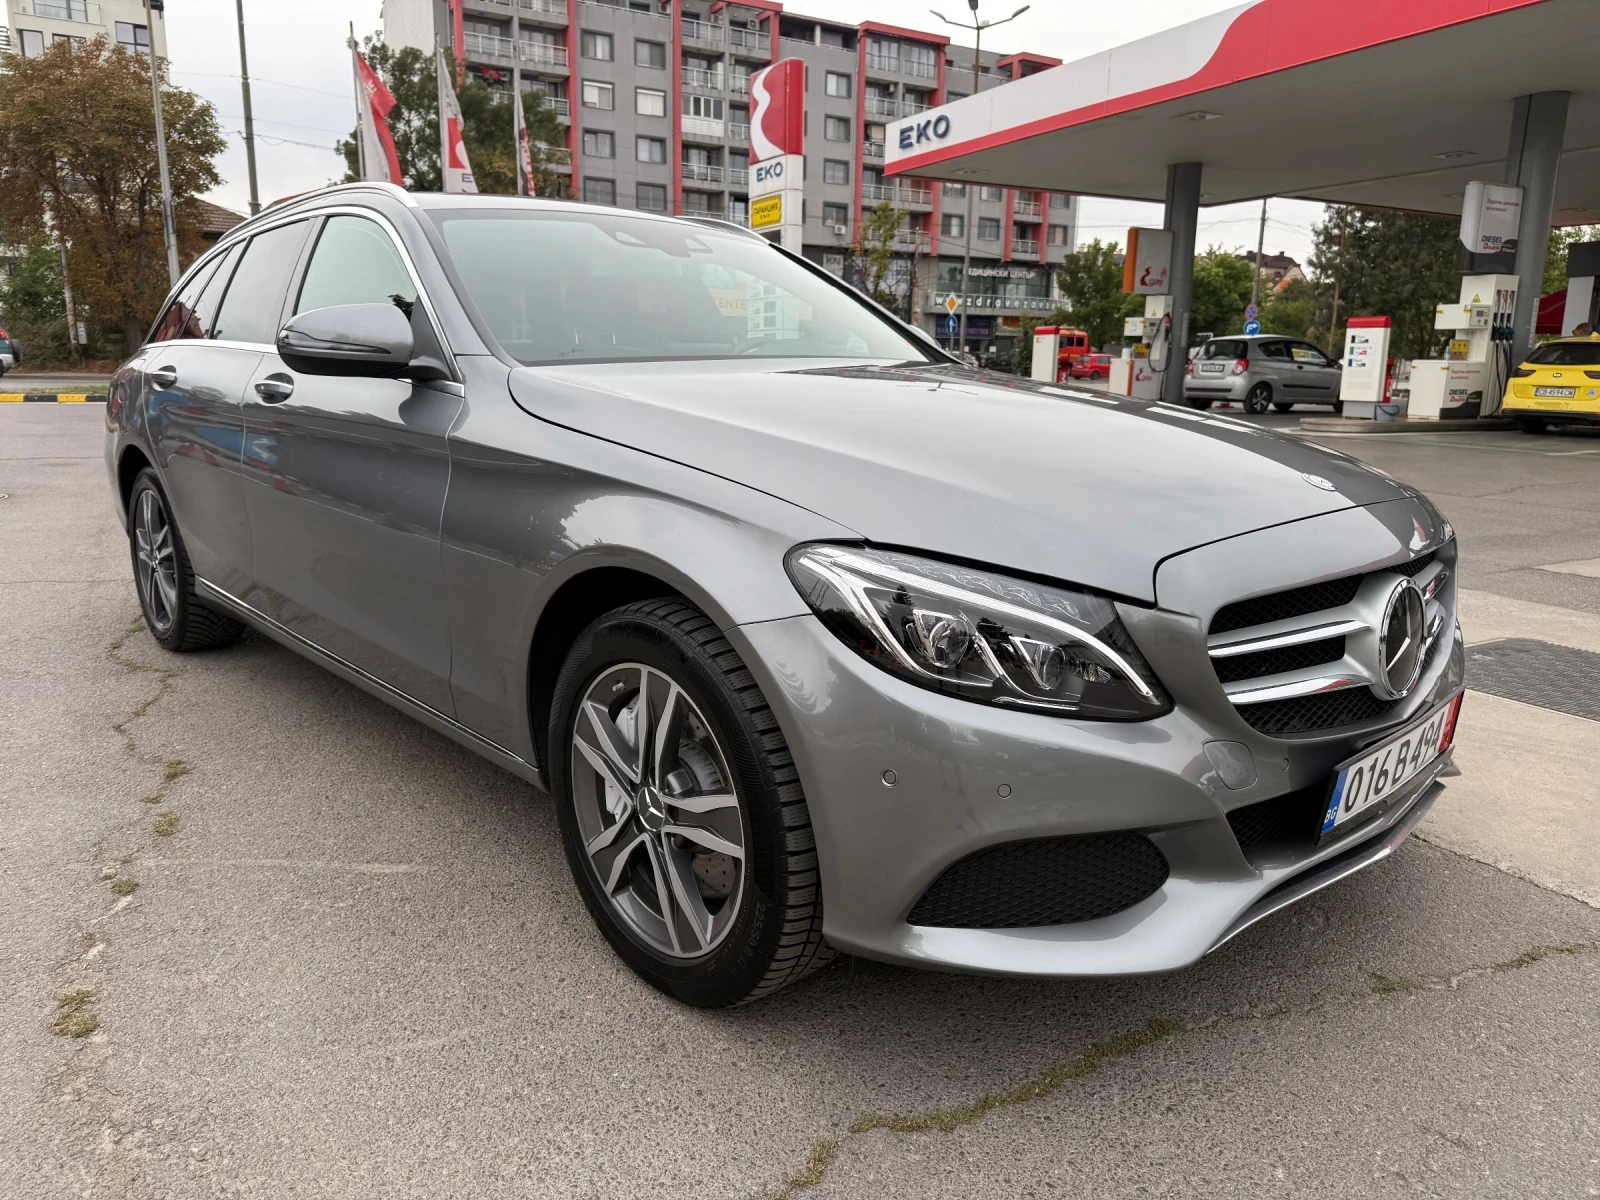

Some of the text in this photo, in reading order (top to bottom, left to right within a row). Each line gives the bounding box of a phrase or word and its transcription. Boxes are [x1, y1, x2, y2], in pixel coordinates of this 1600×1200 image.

[899, 115, 950, 149] EKO
[756, 162, 783, 182] EKO
[1481, 235, 1502, 243] DIESEL
[1449, 388, 1468, 396] DIESEL
[1324, 806, 1338, 822] BG
